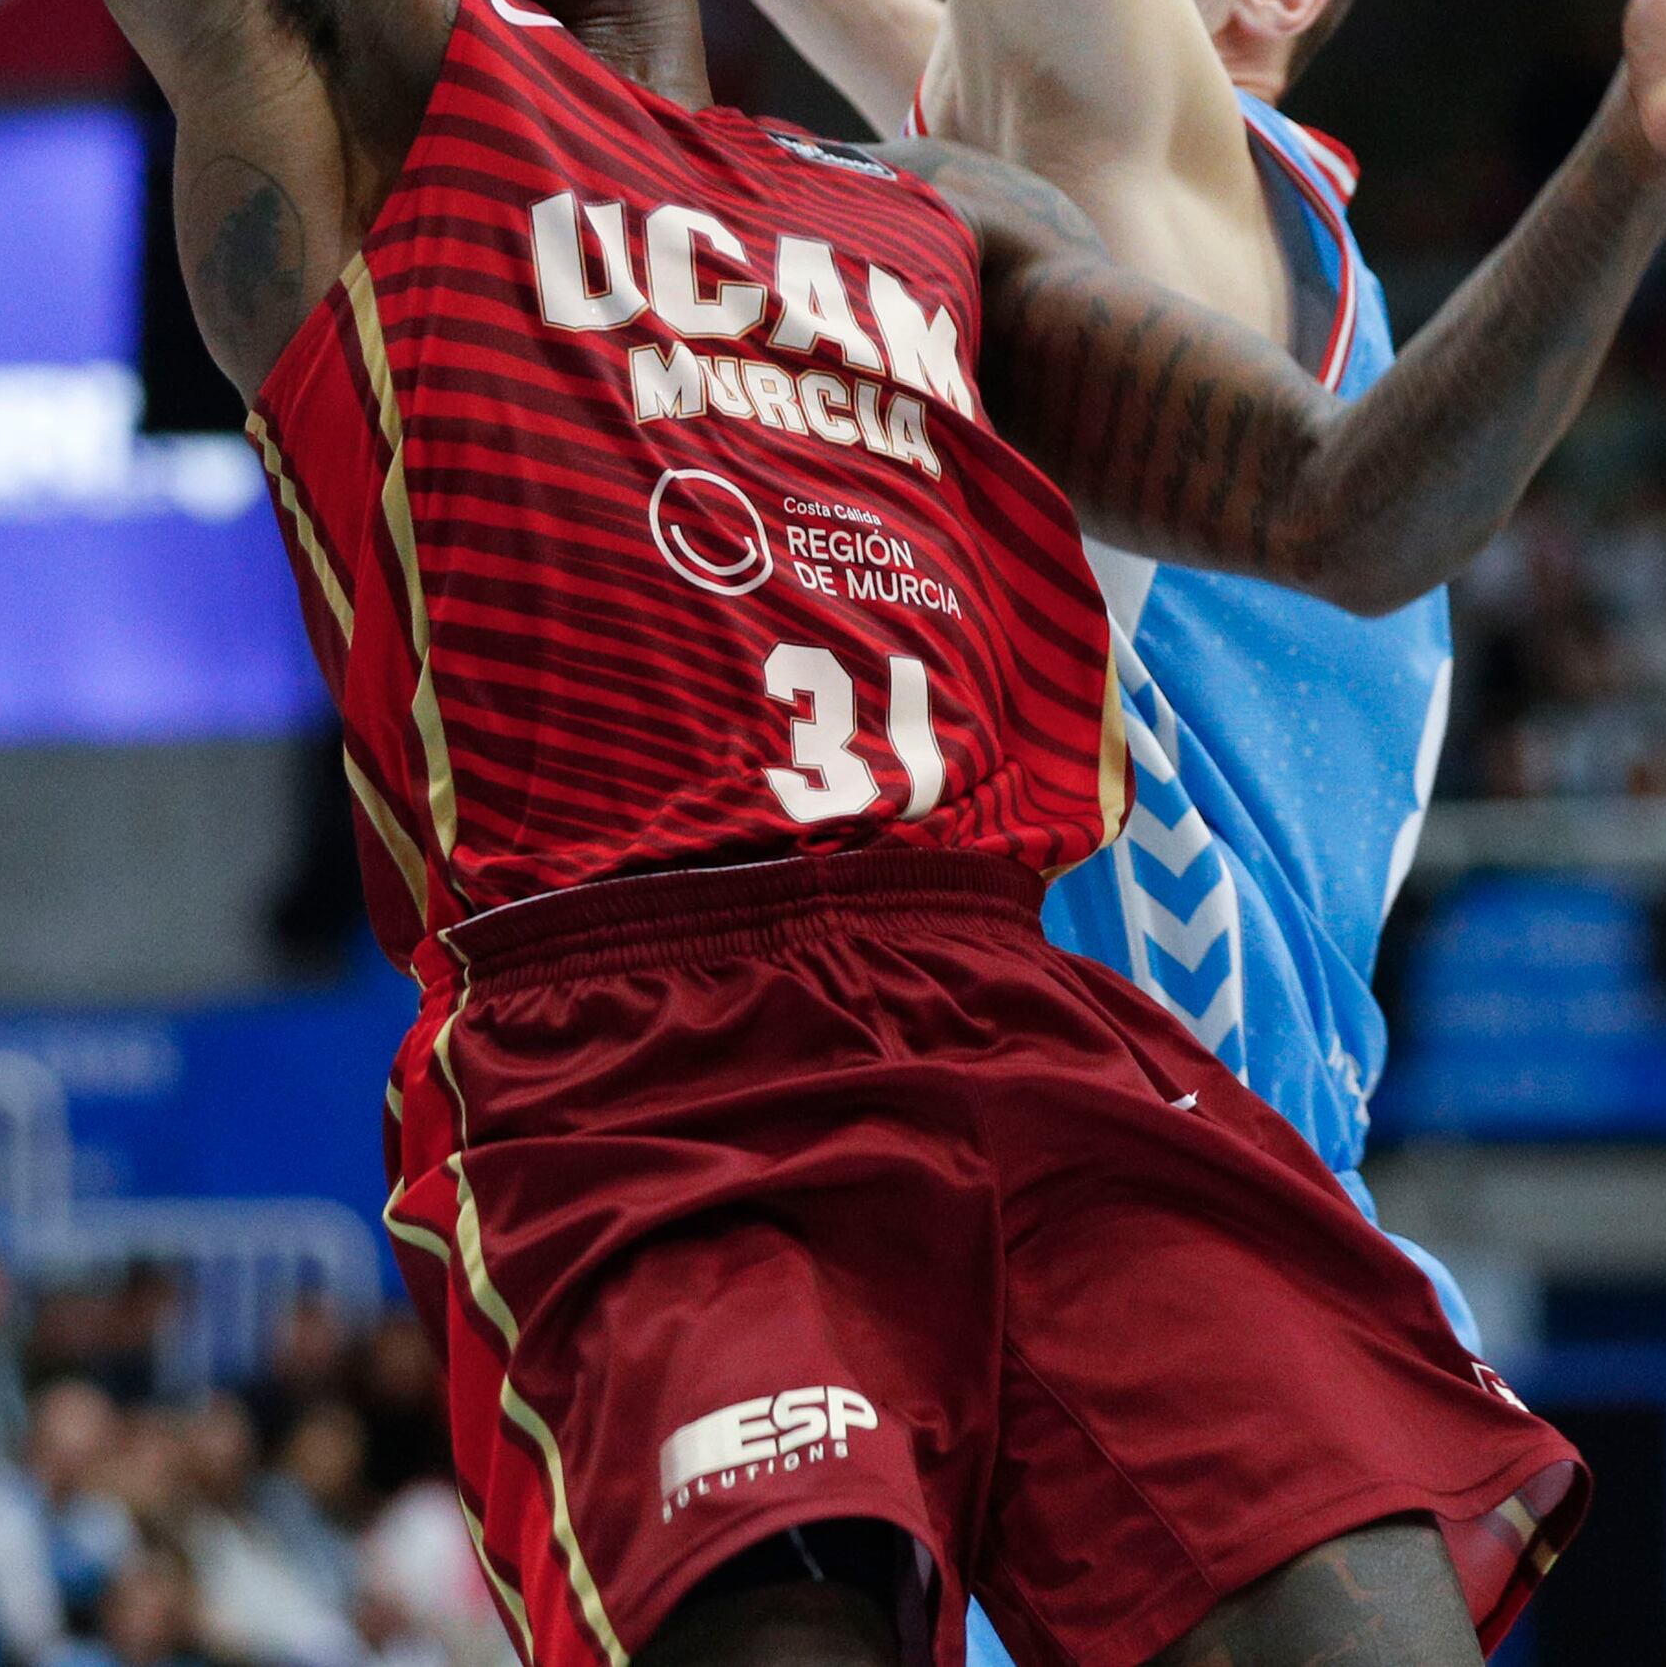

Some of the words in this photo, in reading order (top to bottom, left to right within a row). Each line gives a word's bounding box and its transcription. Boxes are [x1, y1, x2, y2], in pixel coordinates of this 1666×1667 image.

[529, 188, 976, 422] UCAM
[627, 340, 943, 481] MURCIA
[783, 496, 831, 518] Costa
[833, 503, 883, 527] Cálida
[786, 524, 915, 570] REGIÓN
[793, 560, 838, 597] DE
[845, 567, 963, 620] MURCIA
[761, 640, 947, 824] 31
